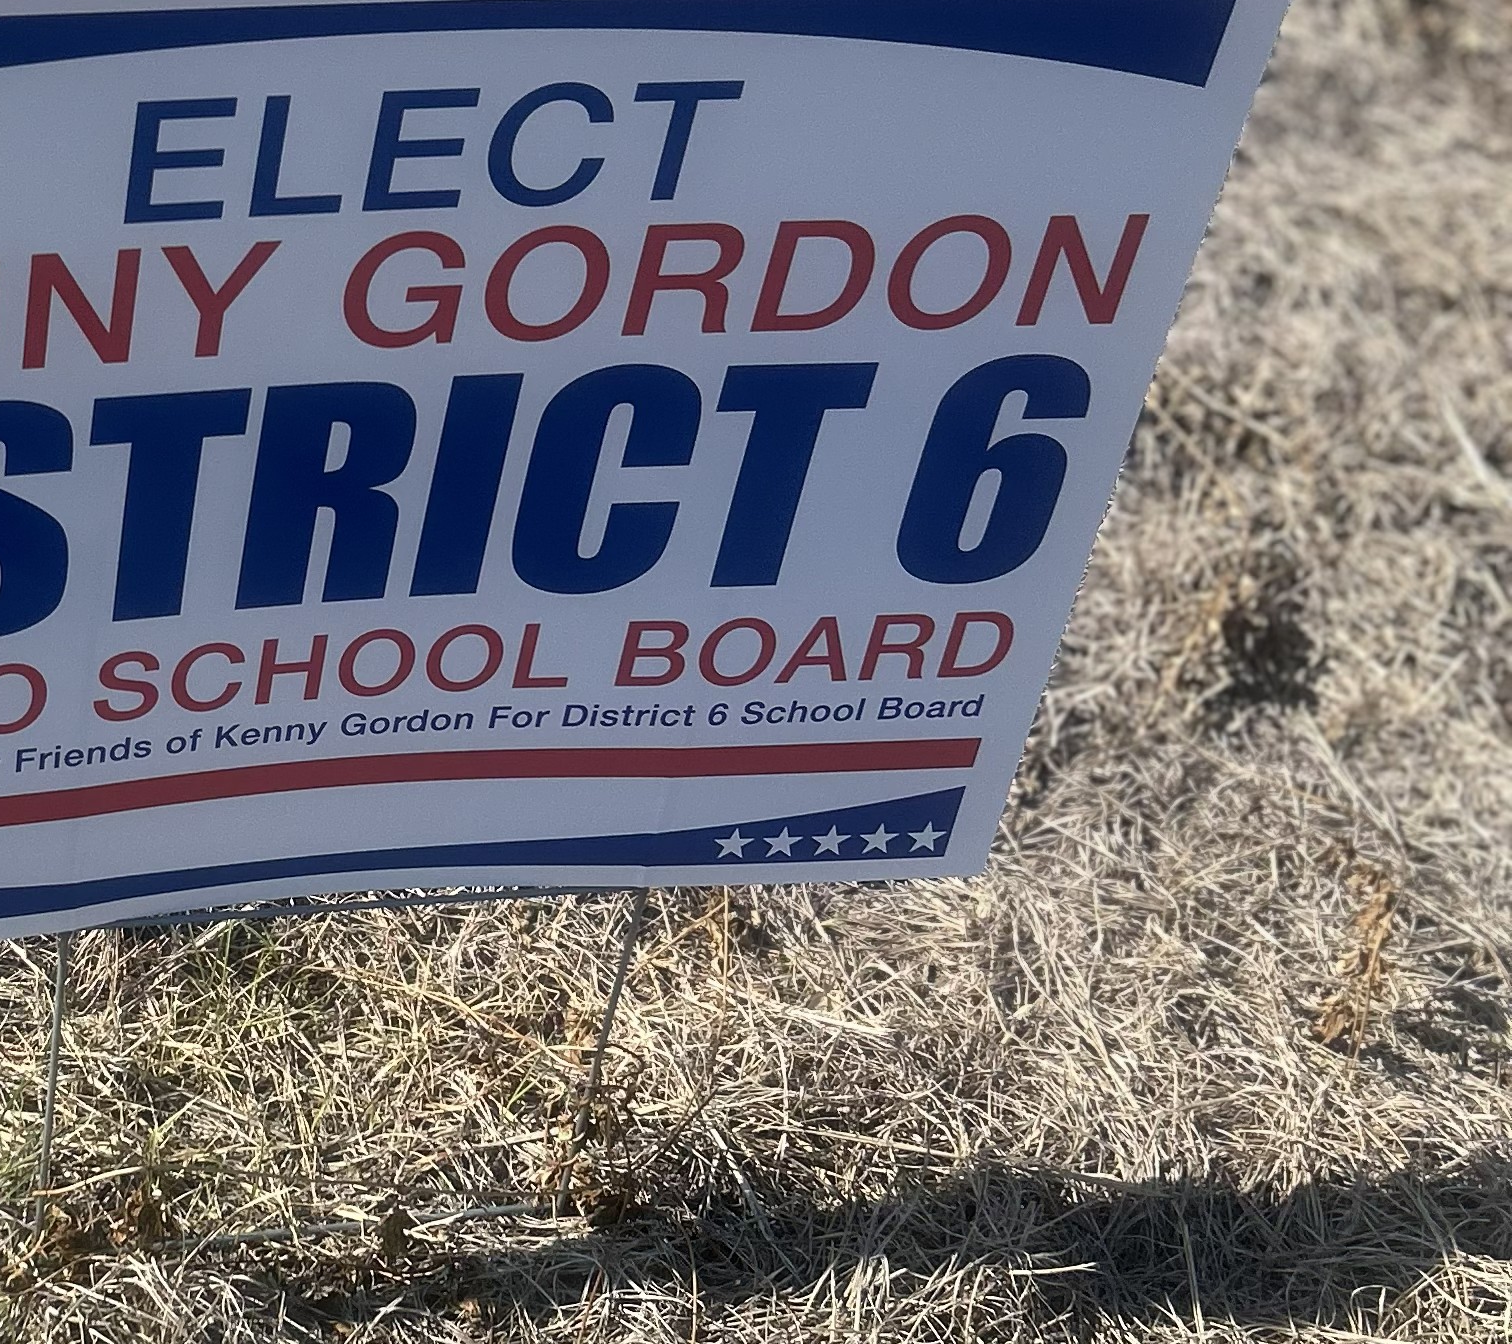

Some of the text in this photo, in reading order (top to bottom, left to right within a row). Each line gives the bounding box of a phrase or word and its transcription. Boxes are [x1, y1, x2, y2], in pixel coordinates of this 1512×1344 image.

[122, 79, 746, 225] ELECT
[342, 213, 1151, 349] GORDON
[895, 353, 1092, 585] 6
[15, 736, 152, 774] Friends
[165, 728, 203, 755] of
[214, 721, 328, 749] Kenny
[340, 709, 474, 737] Gordon
[488, 705, 551, 729] For
[561, 703, 697, 728] District
[707, 702, 729, 727] 6
[740, 697, 867, 725] School
[877, 693, 986, 721] Board
[93, 623, 569, 723] SCHOOL
[613, 611, 1015, 687] BOARD
